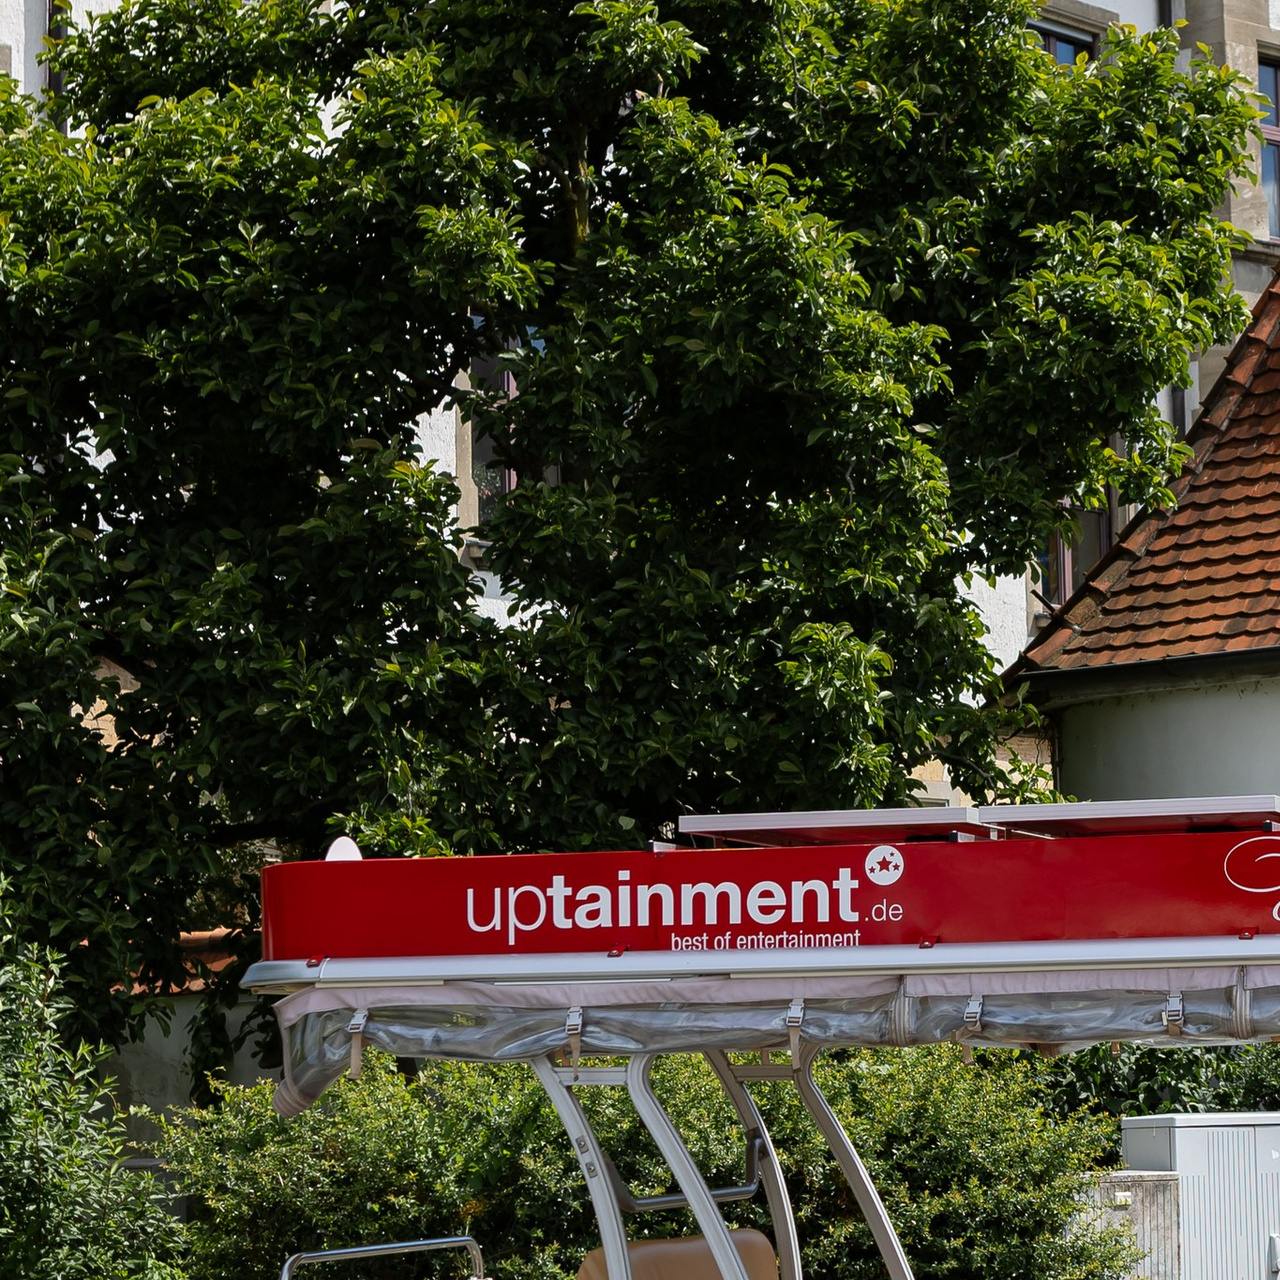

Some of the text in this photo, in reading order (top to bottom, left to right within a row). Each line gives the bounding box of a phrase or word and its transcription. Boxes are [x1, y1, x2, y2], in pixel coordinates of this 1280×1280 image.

[466, 869, 859, 945] uptainment
[670, 929, 861, 951] best of entertainment
